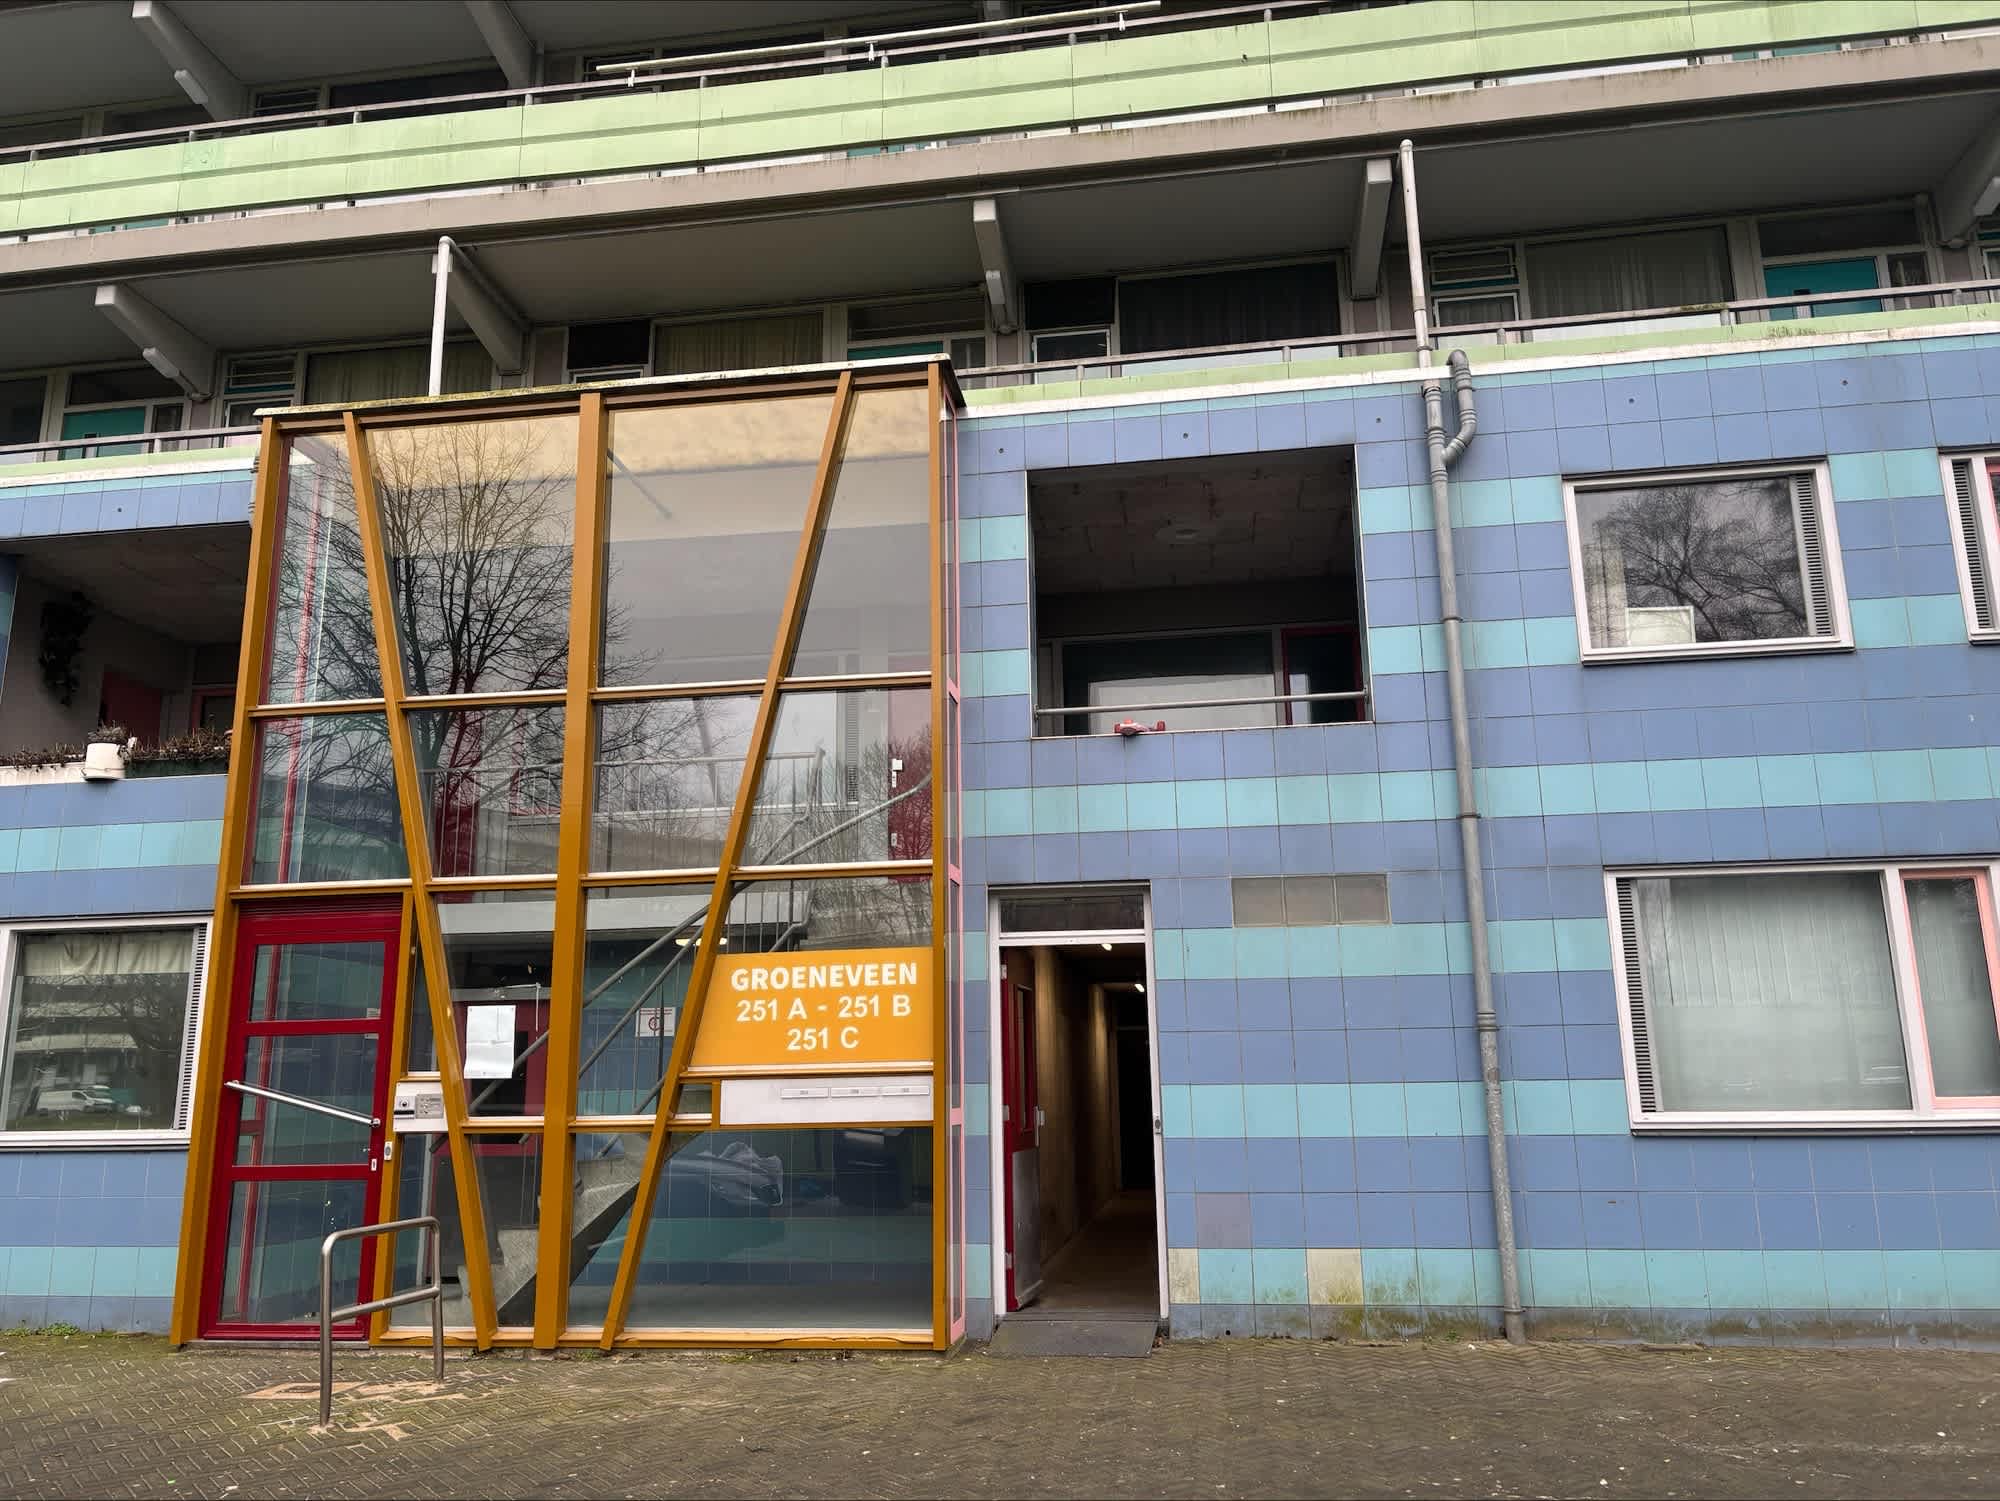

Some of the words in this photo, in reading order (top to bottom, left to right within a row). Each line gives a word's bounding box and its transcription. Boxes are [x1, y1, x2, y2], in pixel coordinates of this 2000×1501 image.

[731, 962, 917, 991] GROENEVEEN
[736, 999, 778, 1022] 251
[788, 997, 807, 1019] A
[838, 995, 879, 1018] 251
[892, 994, 911, 1017] B
[787, 1027, 828, 1051] 251
[840, 1026, 859, 1049] C
